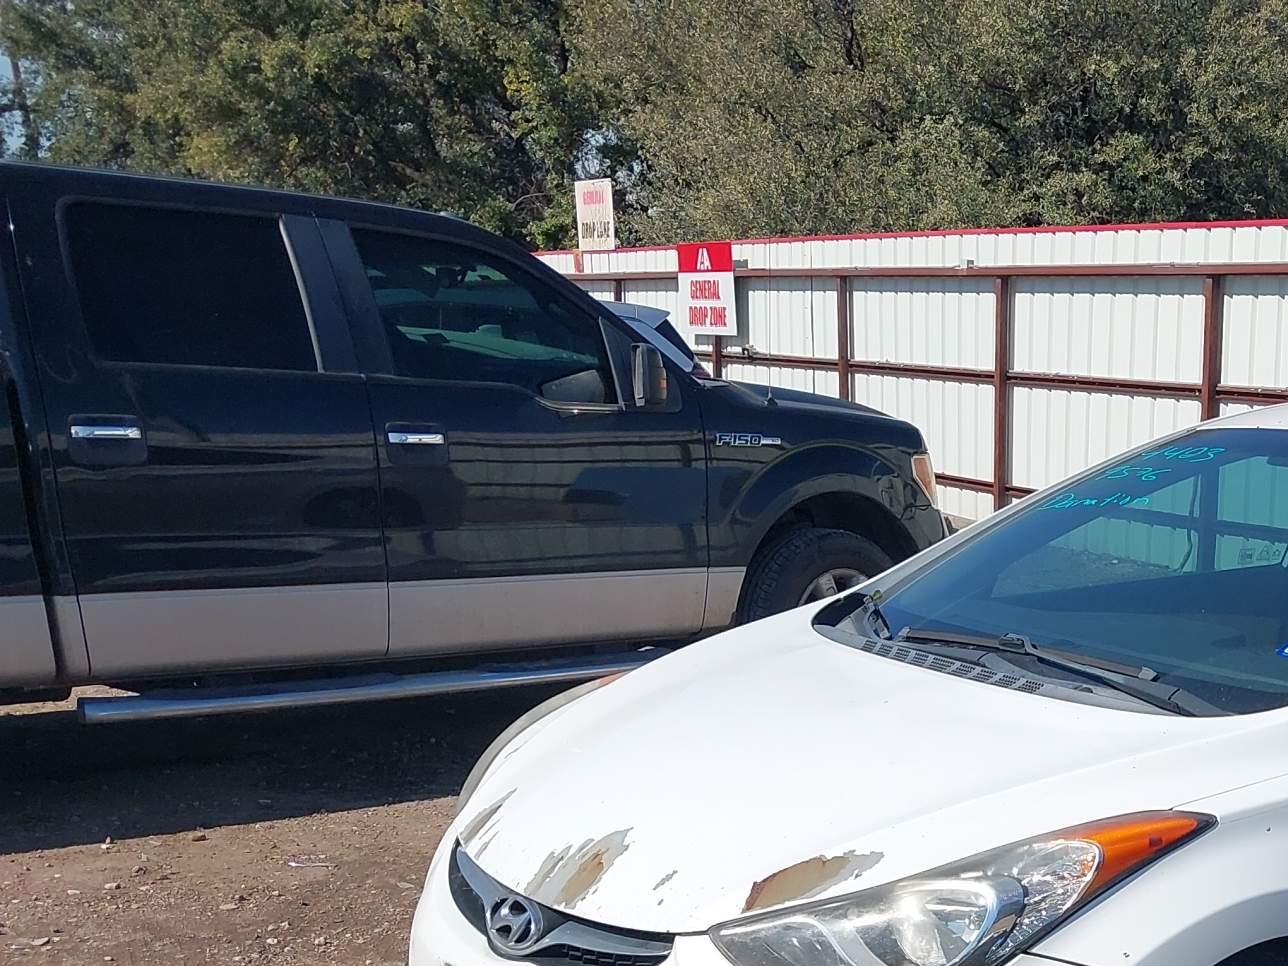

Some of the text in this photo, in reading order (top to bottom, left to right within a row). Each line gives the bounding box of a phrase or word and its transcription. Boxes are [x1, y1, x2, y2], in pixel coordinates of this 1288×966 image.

[690, 279, 721, 300] GENERAL
[688, 305, 728, 328] DROP ZONE
